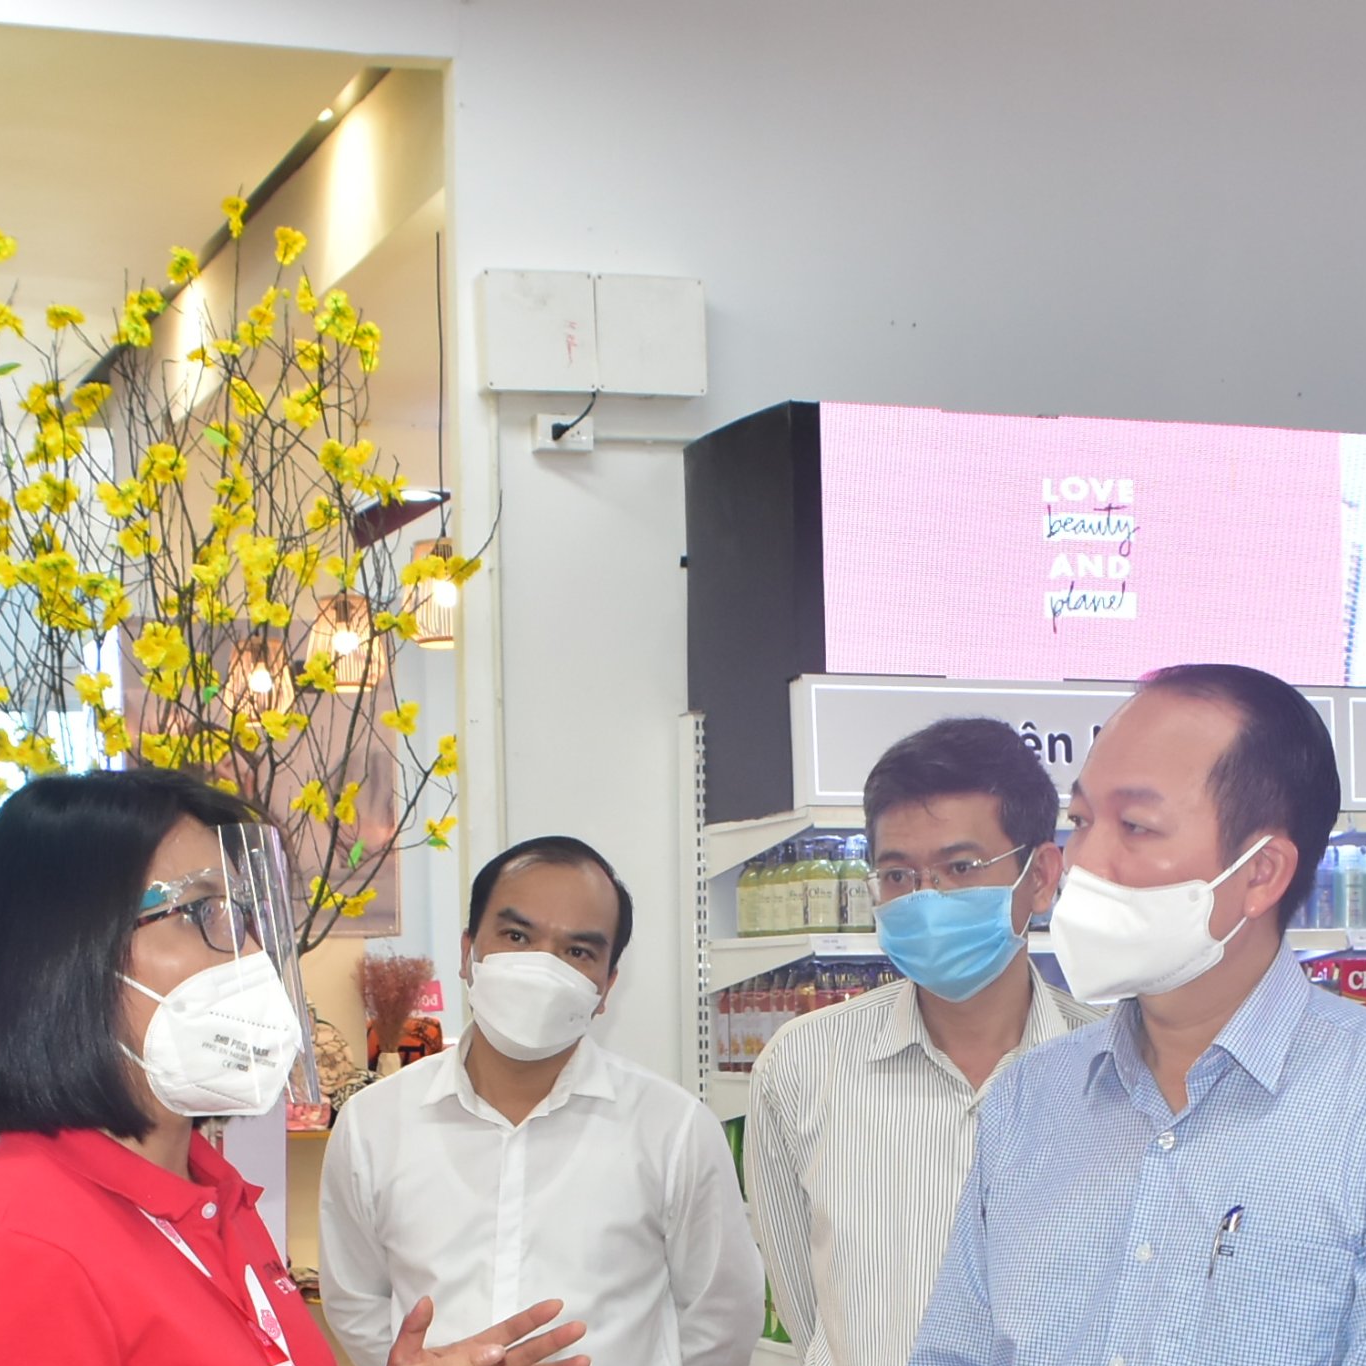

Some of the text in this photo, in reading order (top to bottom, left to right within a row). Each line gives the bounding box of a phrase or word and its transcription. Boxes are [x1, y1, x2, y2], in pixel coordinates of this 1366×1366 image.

[1042, 476, 1134, 502] LOVE
[1047, 503, 1140, 557] beauty
[1049, 552, 1131, 578] AND
